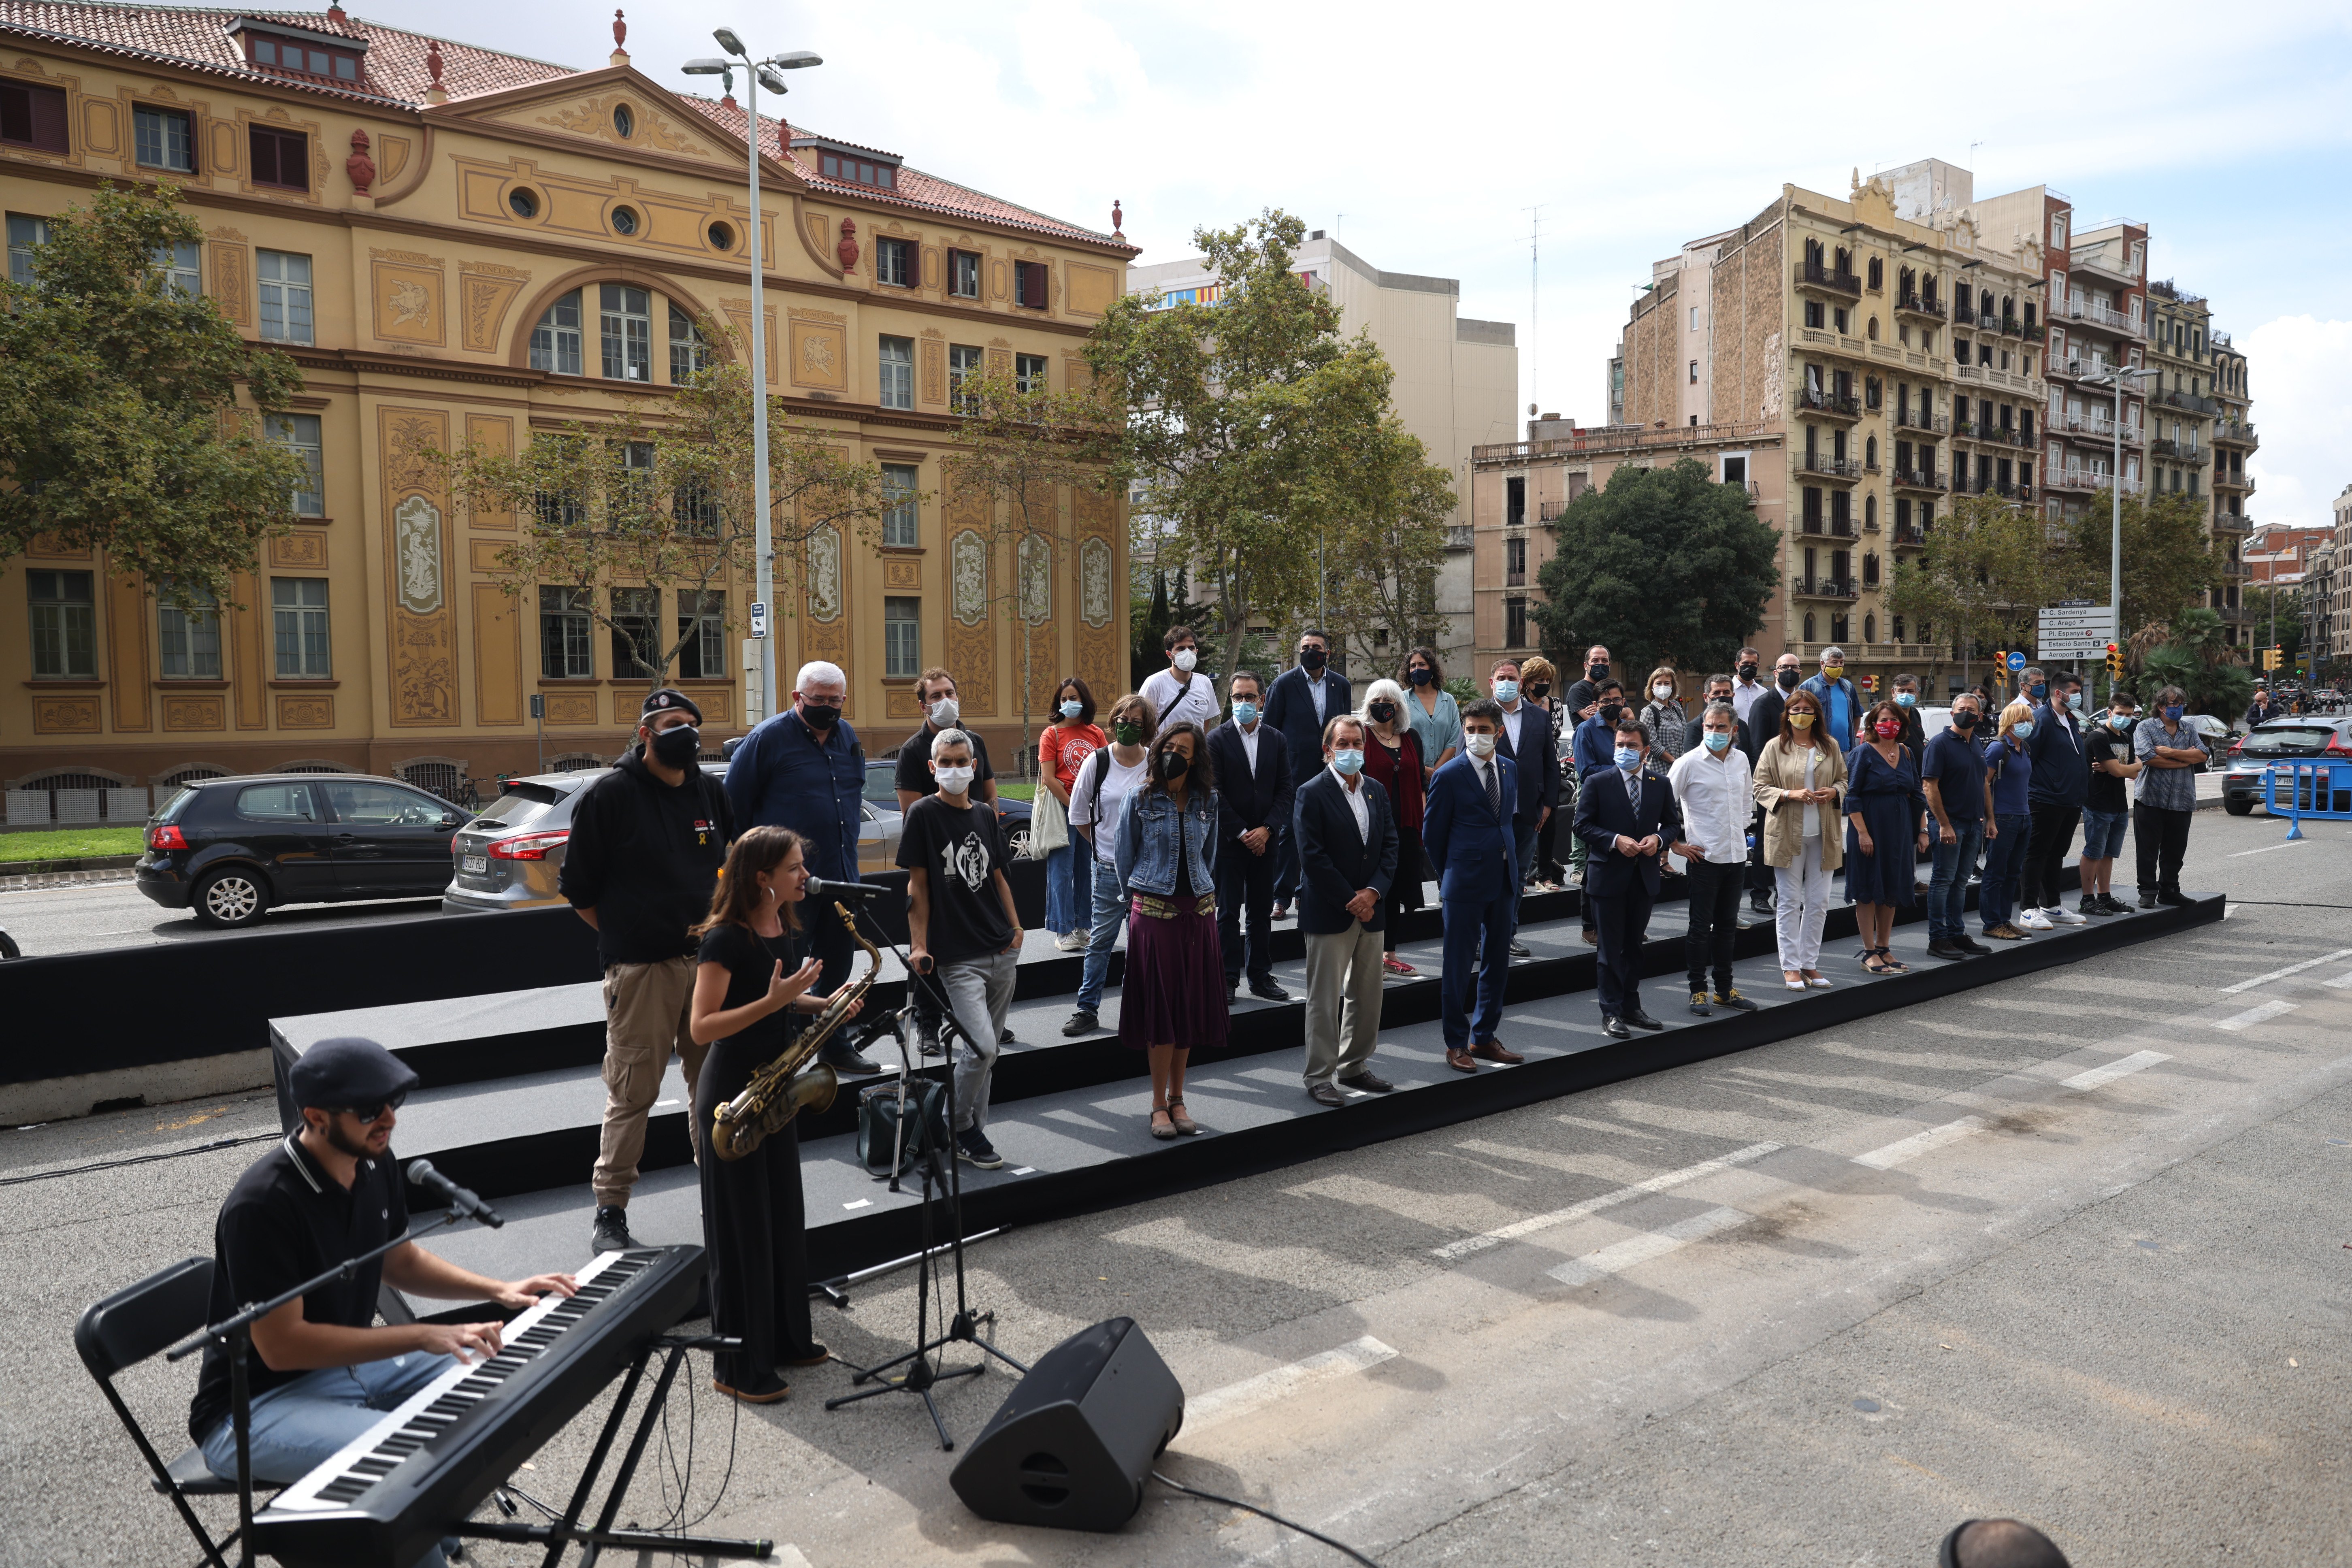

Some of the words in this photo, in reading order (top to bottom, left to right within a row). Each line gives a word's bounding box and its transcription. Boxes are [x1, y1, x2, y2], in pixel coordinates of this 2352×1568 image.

[802, 311, 833, 320] COMENIO
[1078, 741, 1094, 751] LLOGAT
[465, 856, 475, 869] 6127
[476, 858, 485, 870] HZG
